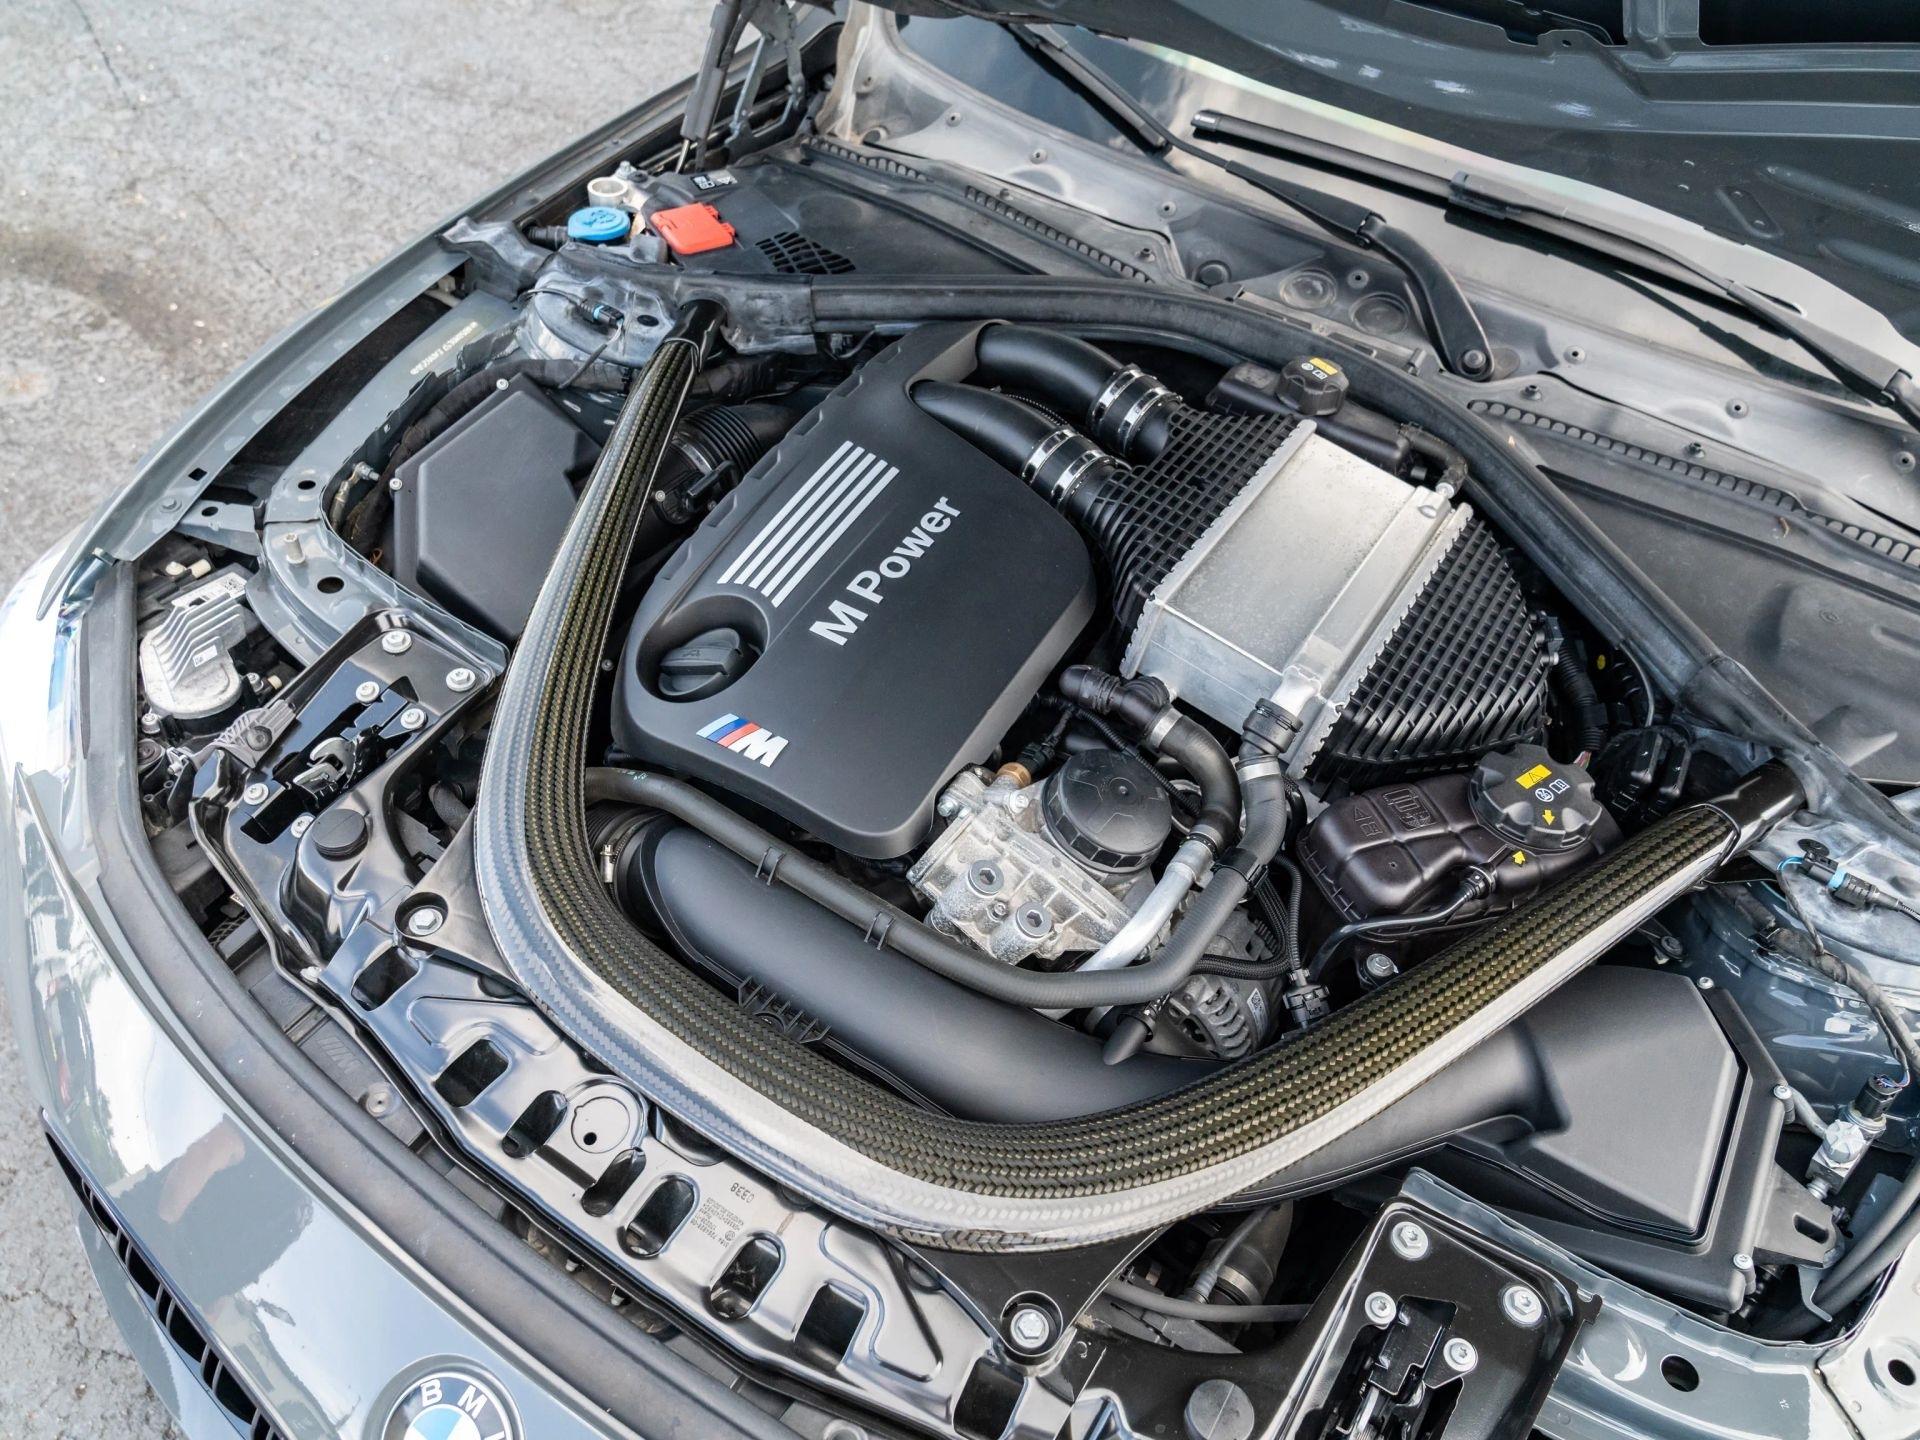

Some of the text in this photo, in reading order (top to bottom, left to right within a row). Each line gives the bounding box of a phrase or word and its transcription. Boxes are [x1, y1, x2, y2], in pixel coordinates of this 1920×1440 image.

[809, 496, 961, 646] M Power
[420, 1378, 505, 1440] BM
